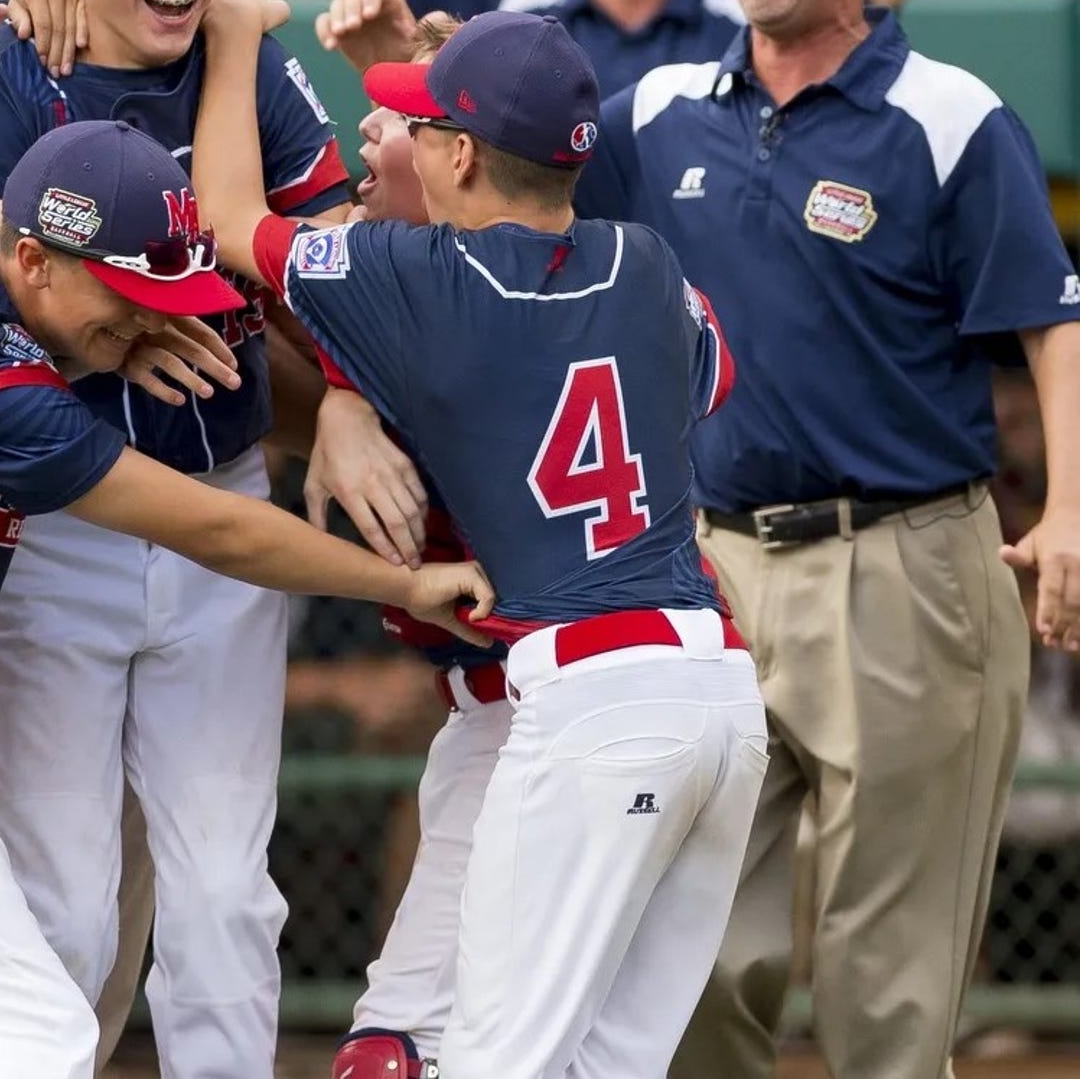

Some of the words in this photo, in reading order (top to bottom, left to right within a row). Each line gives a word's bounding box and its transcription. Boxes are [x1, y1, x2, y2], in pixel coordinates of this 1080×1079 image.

[42, 196, 94, 221] World
[41, 210, 95, 236] Series
[527, 354, 650, 561] 4
